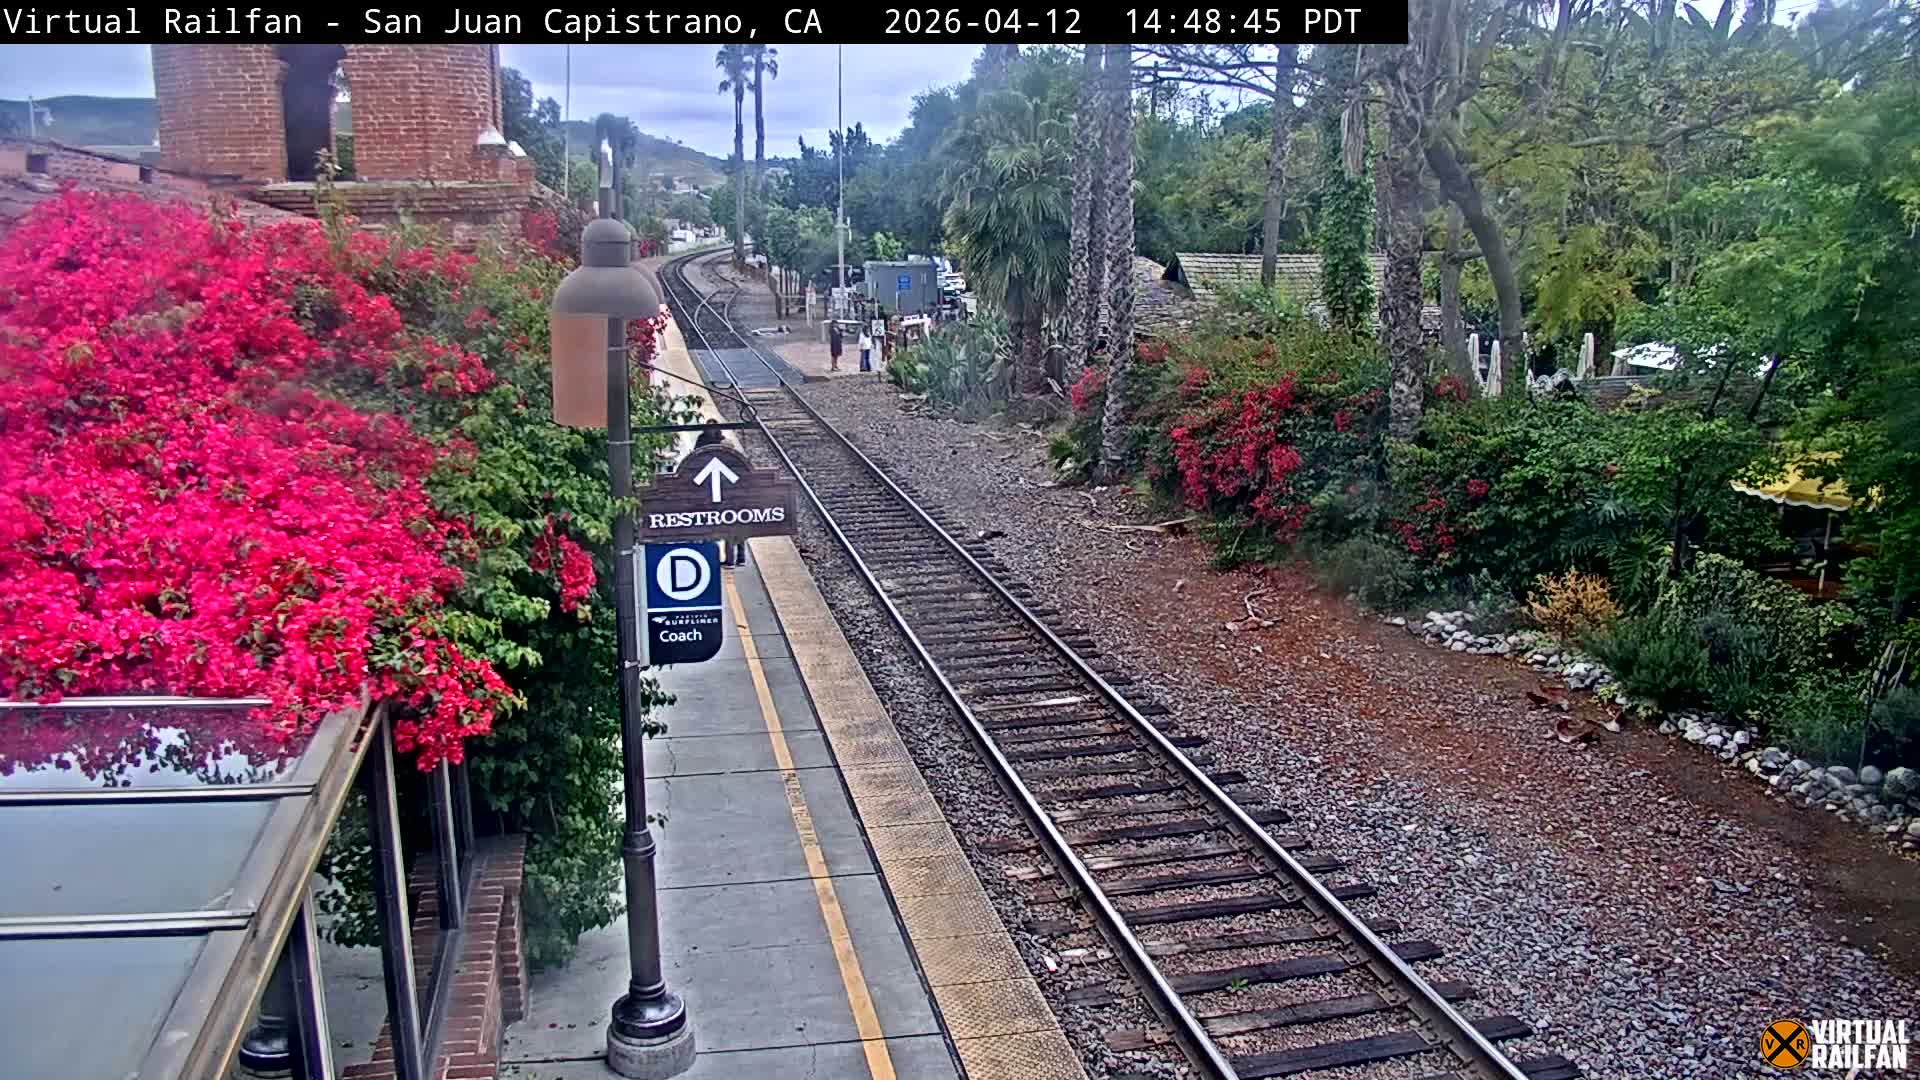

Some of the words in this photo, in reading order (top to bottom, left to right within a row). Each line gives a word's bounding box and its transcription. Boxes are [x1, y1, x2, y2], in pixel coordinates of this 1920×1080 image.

[650, 507, 784, 528] RESTROOMS
[670, 556, 702, 592] D
[660, 628, 702, 642] Coach
